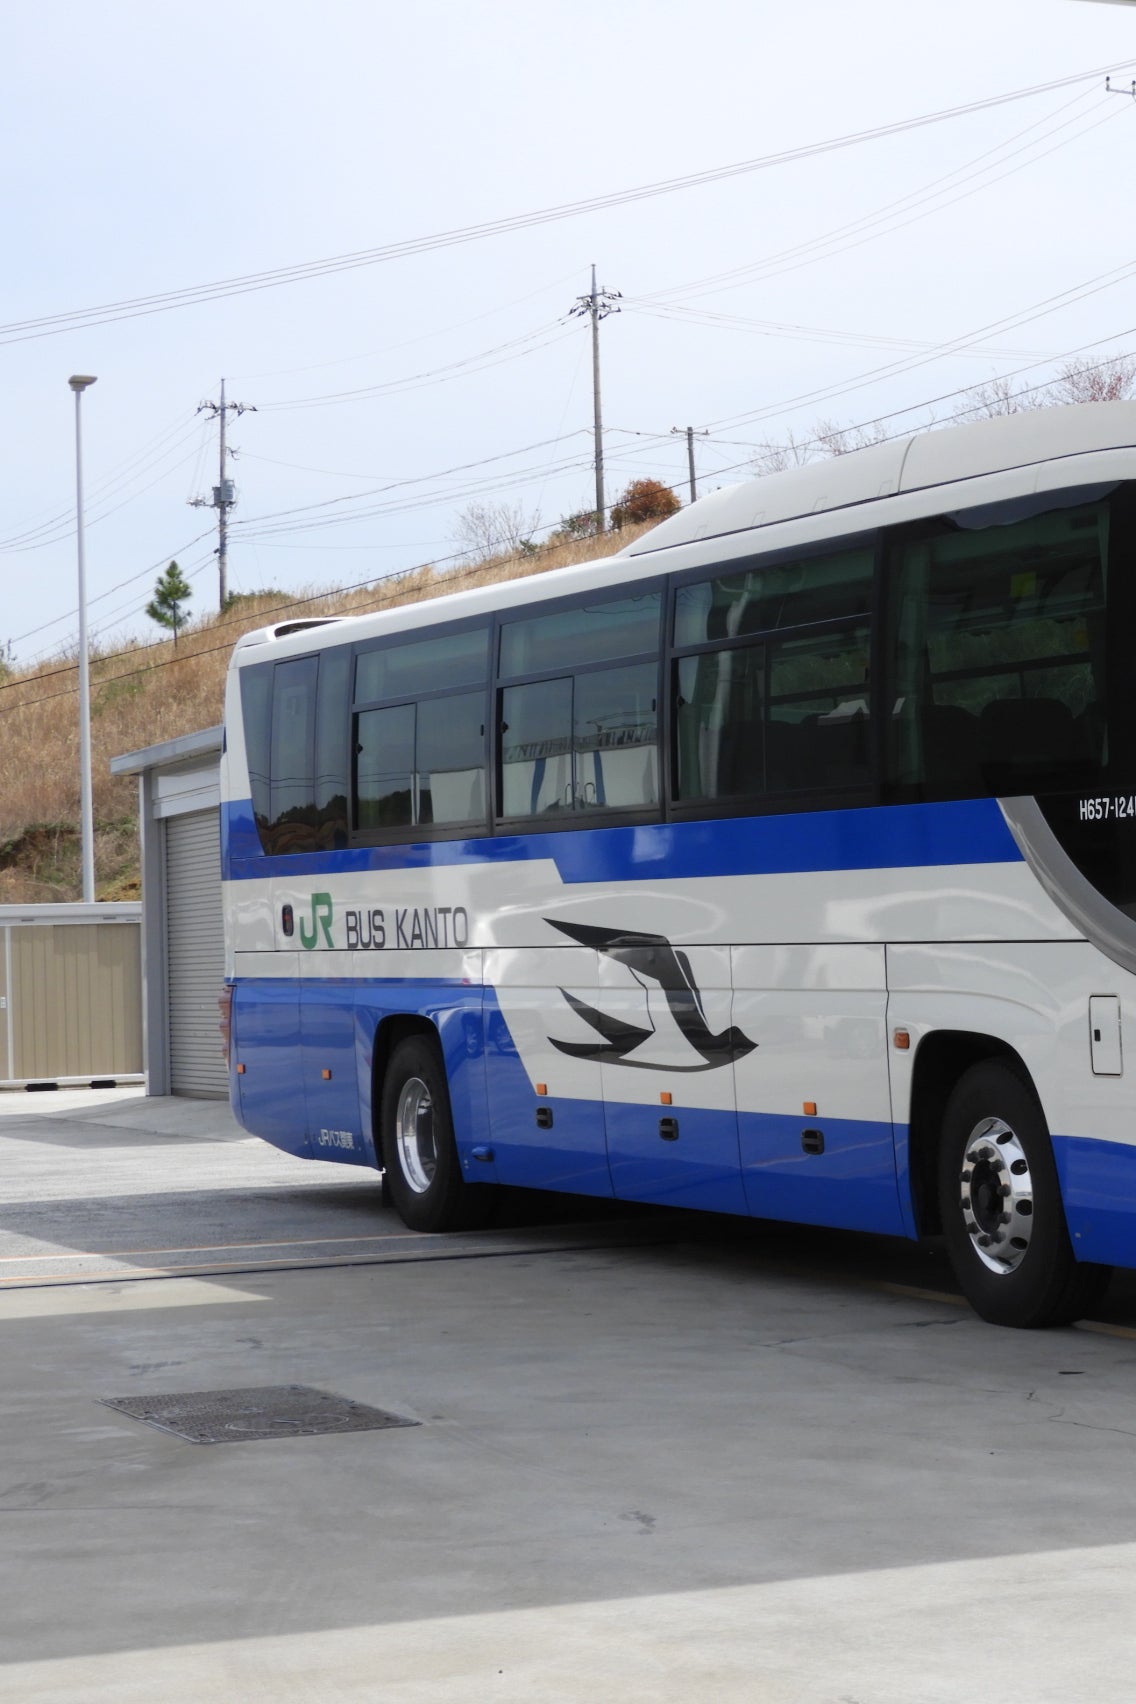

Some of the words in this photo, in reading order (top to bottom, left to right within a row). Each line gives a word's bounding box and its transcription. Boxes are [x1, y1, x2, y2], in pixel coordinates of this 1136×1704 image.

[299, 893, 335, 950] JR
[346, 910, 386, 949] BUS
[396, 907, 468, 948] KANTO
